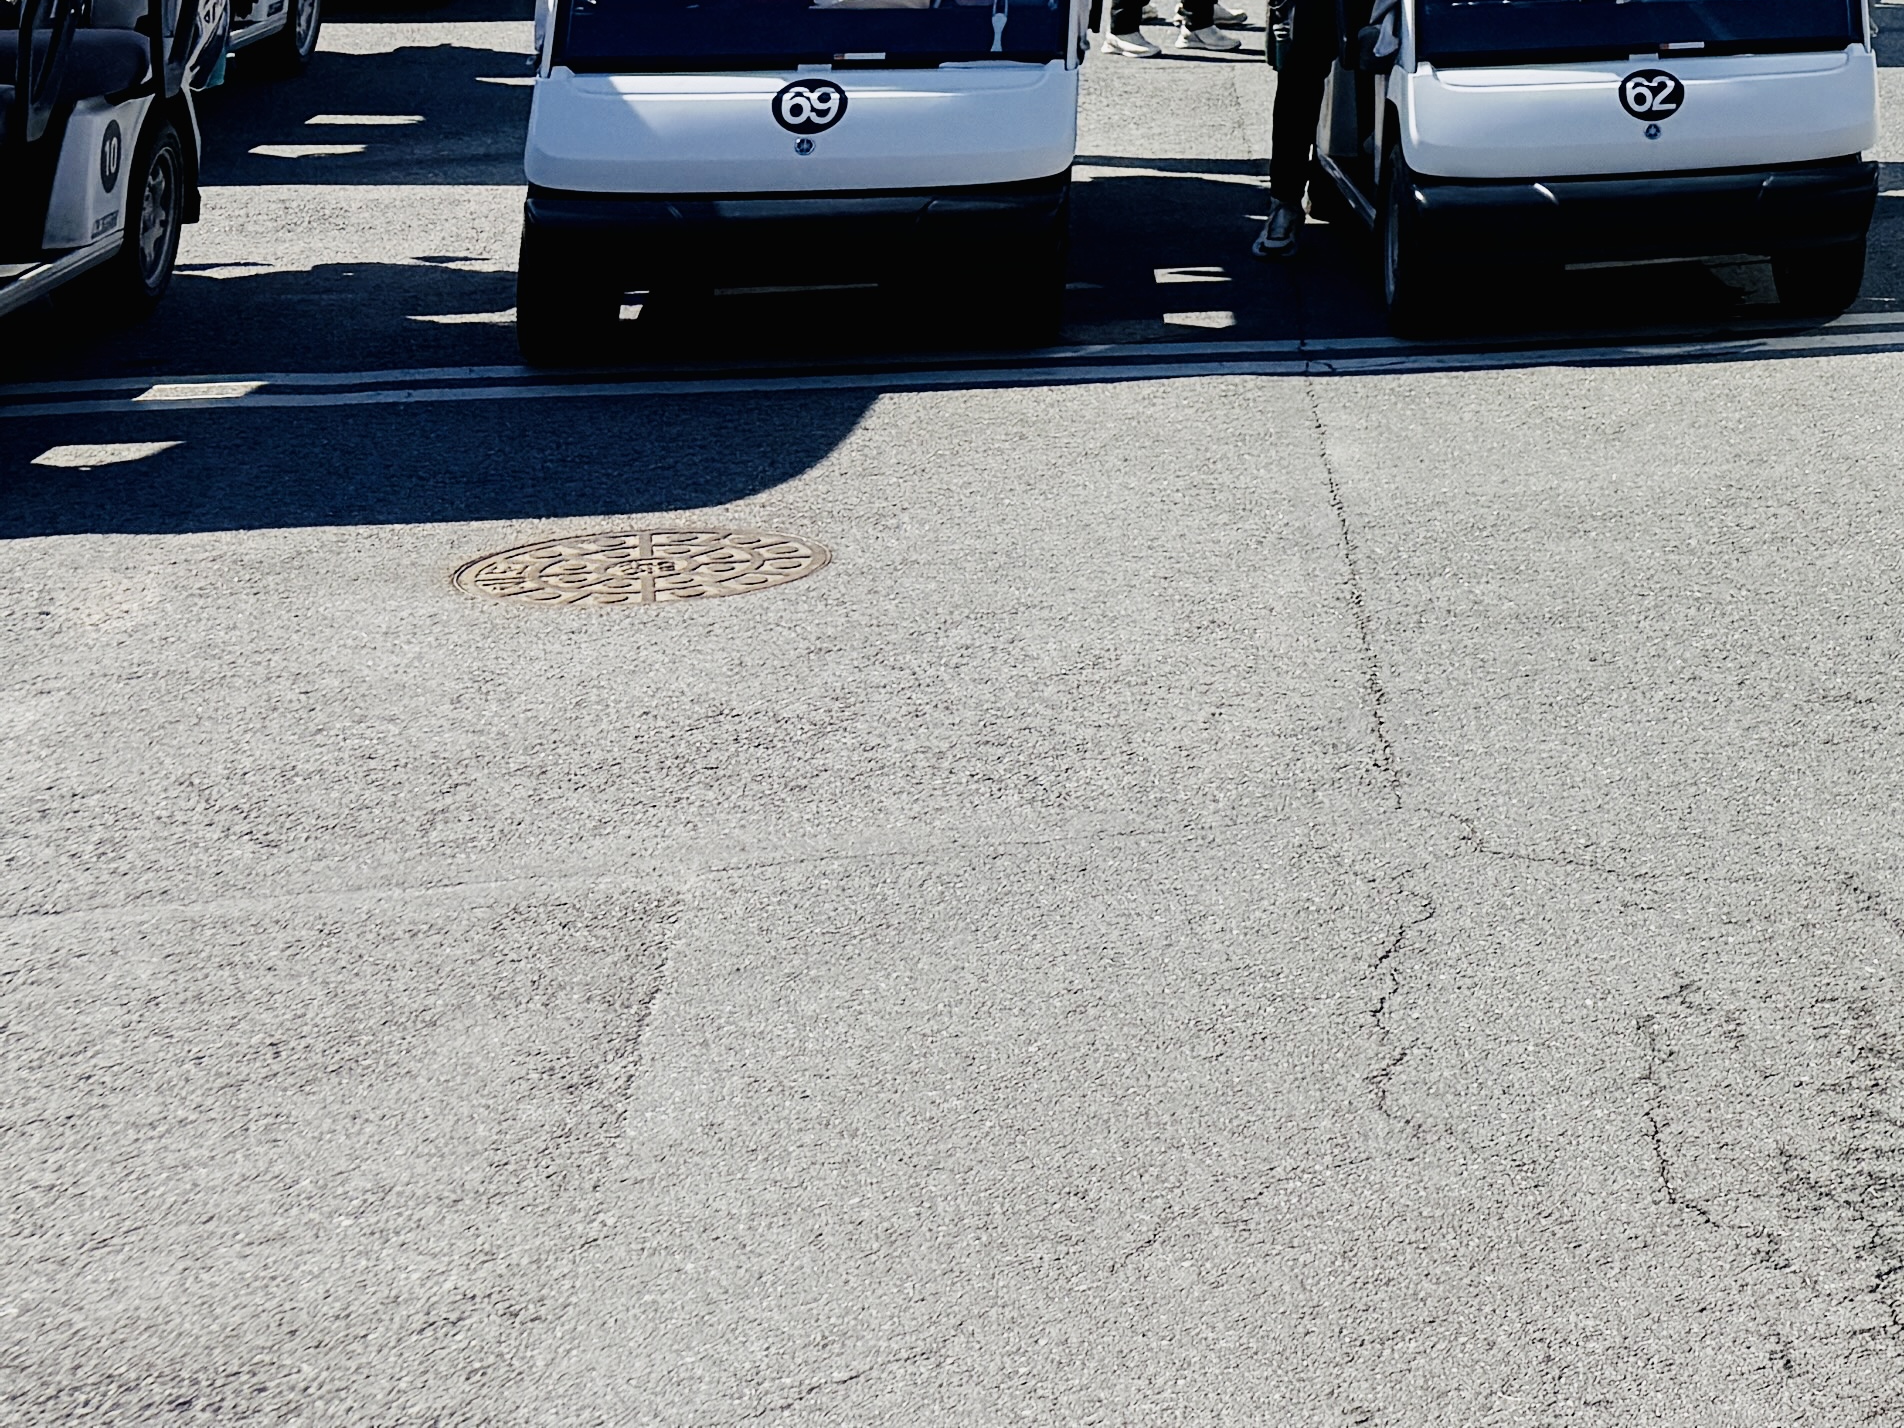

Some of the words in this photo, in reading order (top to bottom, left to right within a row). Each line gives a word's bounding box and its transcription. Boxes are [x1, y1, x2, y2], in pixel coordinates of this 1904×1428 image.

[781, 86, 841, 125] 69
[1625, 75, 1677, 113] 62
[105, 136, 118, 176] 10
